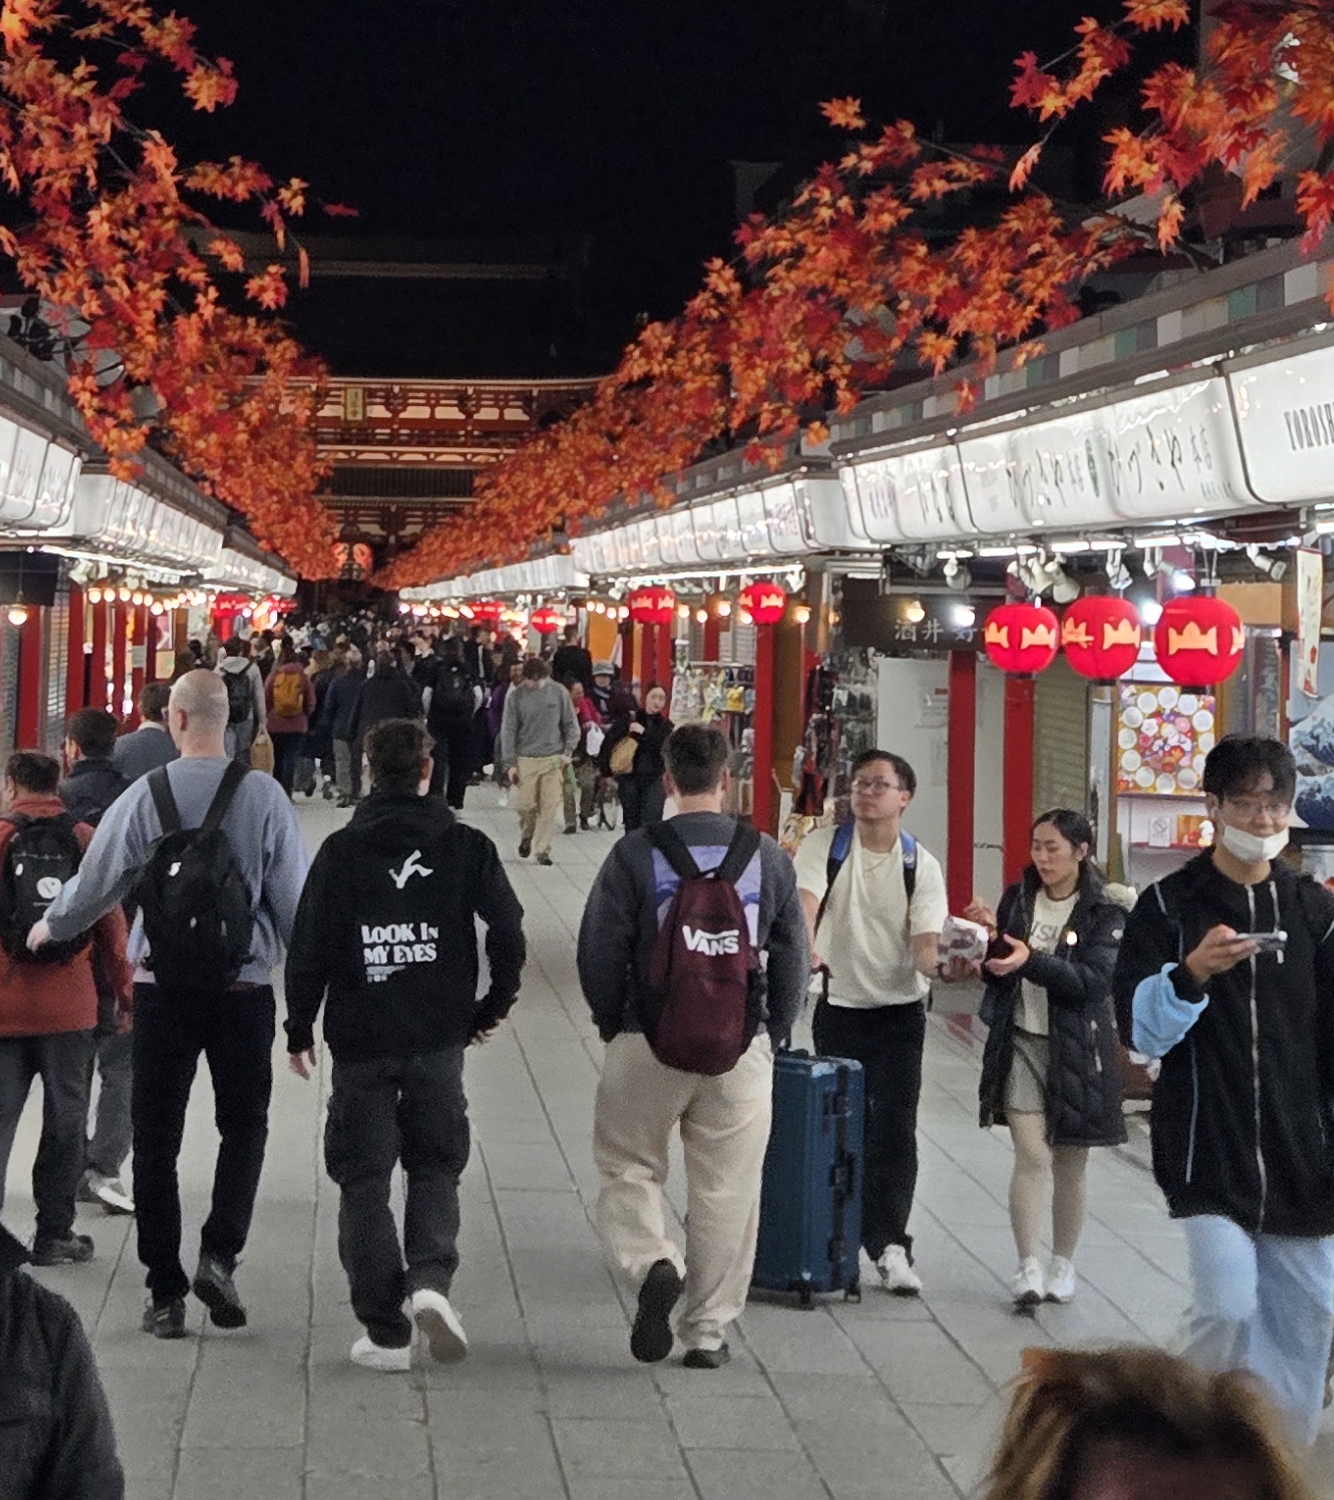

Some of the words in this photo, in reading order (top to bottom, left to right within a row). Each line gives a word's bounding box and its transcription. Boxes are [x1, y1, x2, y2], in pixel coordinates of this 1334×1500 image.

[361, 923, 416, 944] LOOK
[682, 925, 740, 956] VANS
[363, 945, 390, 965] MY
[393, 943, 438, 964] EYES
